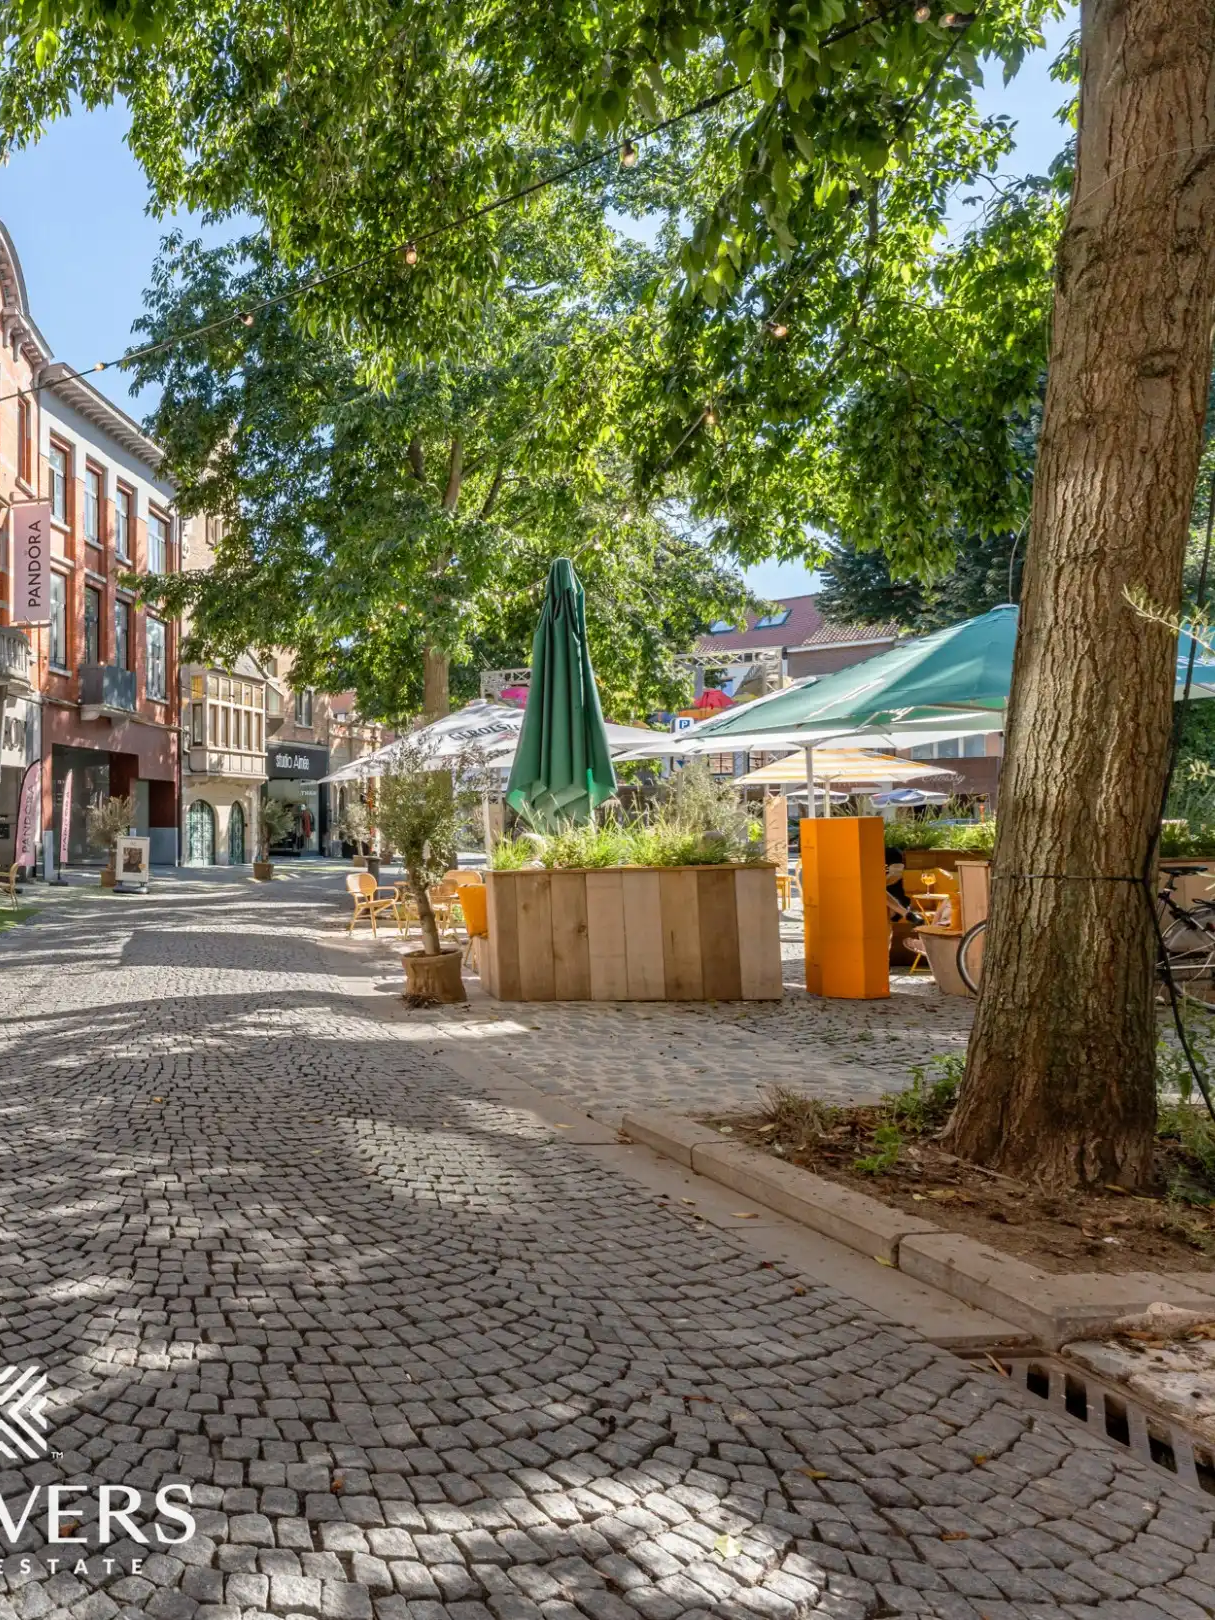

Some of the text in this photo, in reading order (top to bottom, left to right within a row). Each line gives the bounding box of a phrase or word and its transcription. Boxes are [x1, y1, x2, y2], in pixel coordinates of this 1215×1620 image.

[28, 519, 42, 608] PANDORA
[682, 720, 688, 729] P
[22, 785, 35, 854] PANDORA
